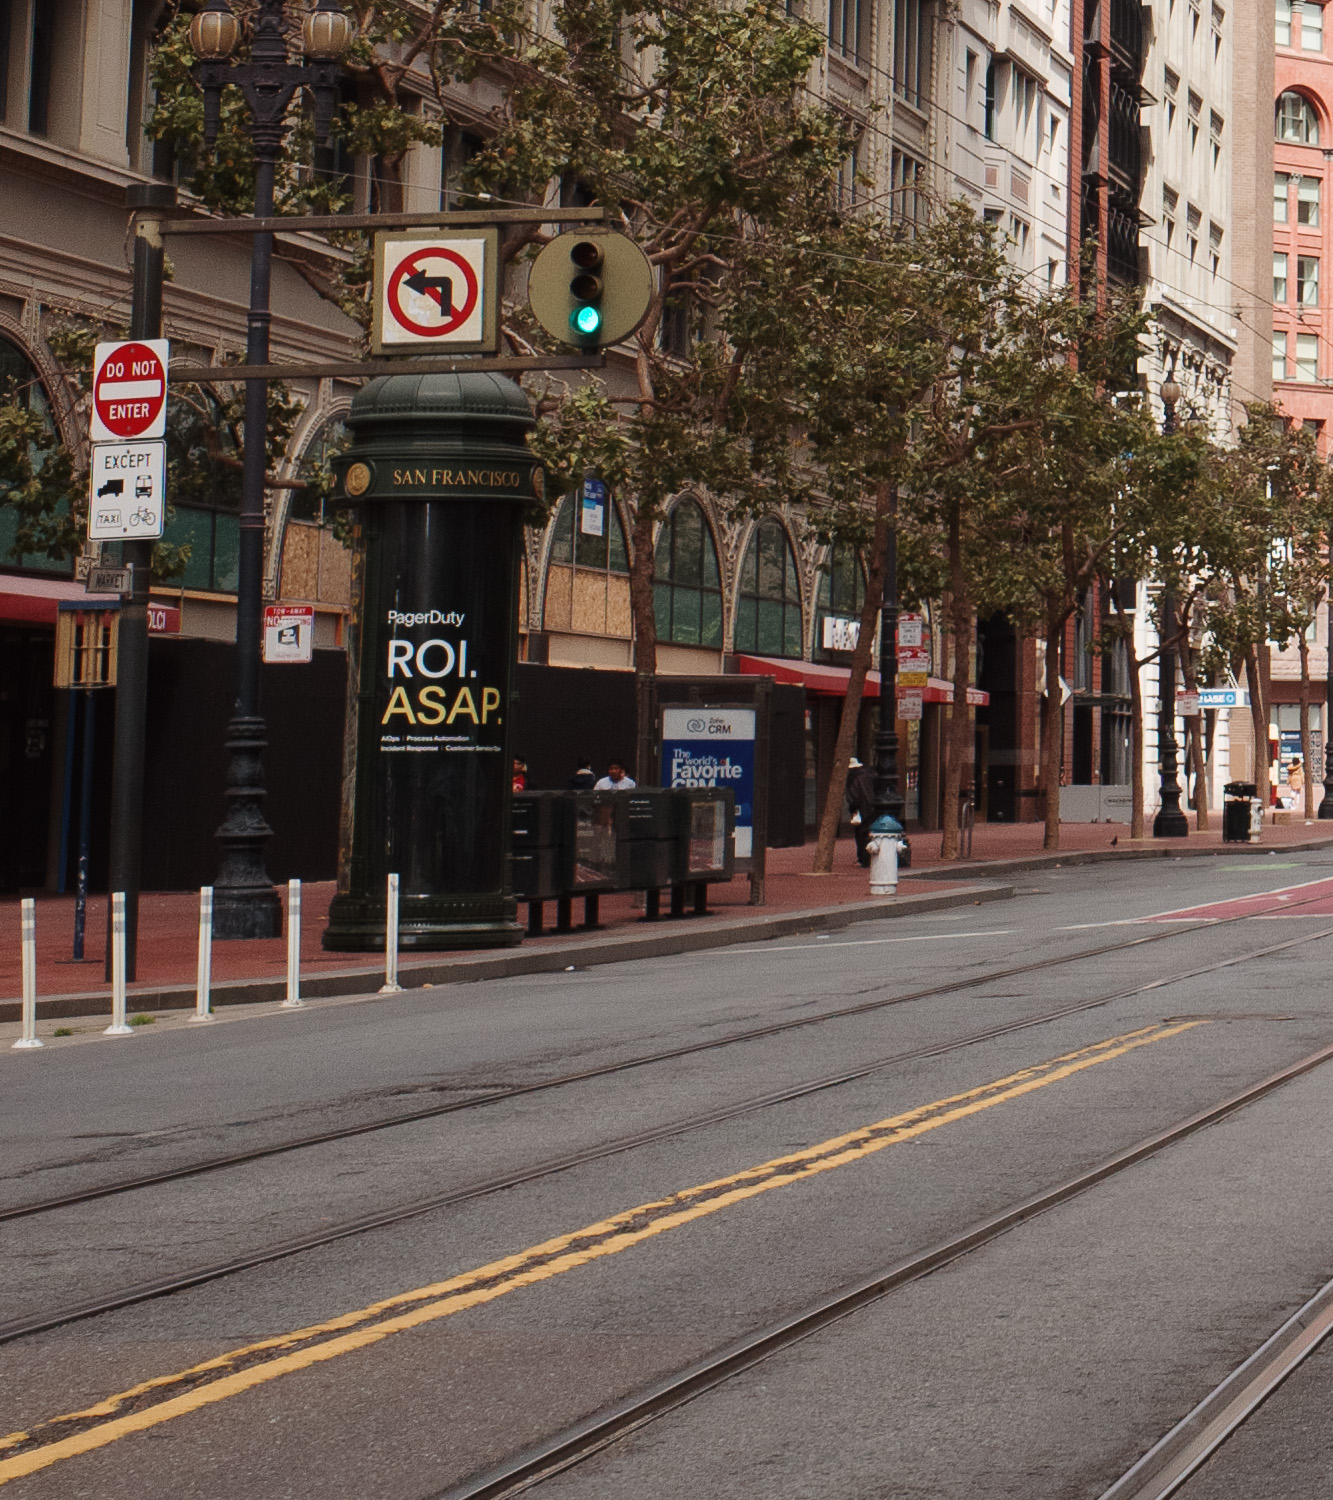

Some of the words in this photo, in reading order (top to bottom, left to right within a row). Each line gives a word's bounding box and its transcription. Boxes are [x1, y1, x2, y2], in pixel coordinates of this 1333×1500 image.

[106, 362, 124, 378] DO
[132, 360, 156, 376] NOT
[109, 403, 150, 420] ENTER
[104, 454, 152, 470] EXCEPT
[394, 469, 426, 485] SAN
[432, 470, 520, 487] FRANCISCO
[99, 514, 120, 524] TAXI
[388, 610, 465, 628] PagerDuty
[388, 639, 477, 678] ROI.
[381, 686, 502, 725] ASAP.
[708, 724, 732, 734] CRM
[673, 748, 690, 758] The
[685, 756, 717, 766] world's
[672, 757, 742, 779] Favorite
